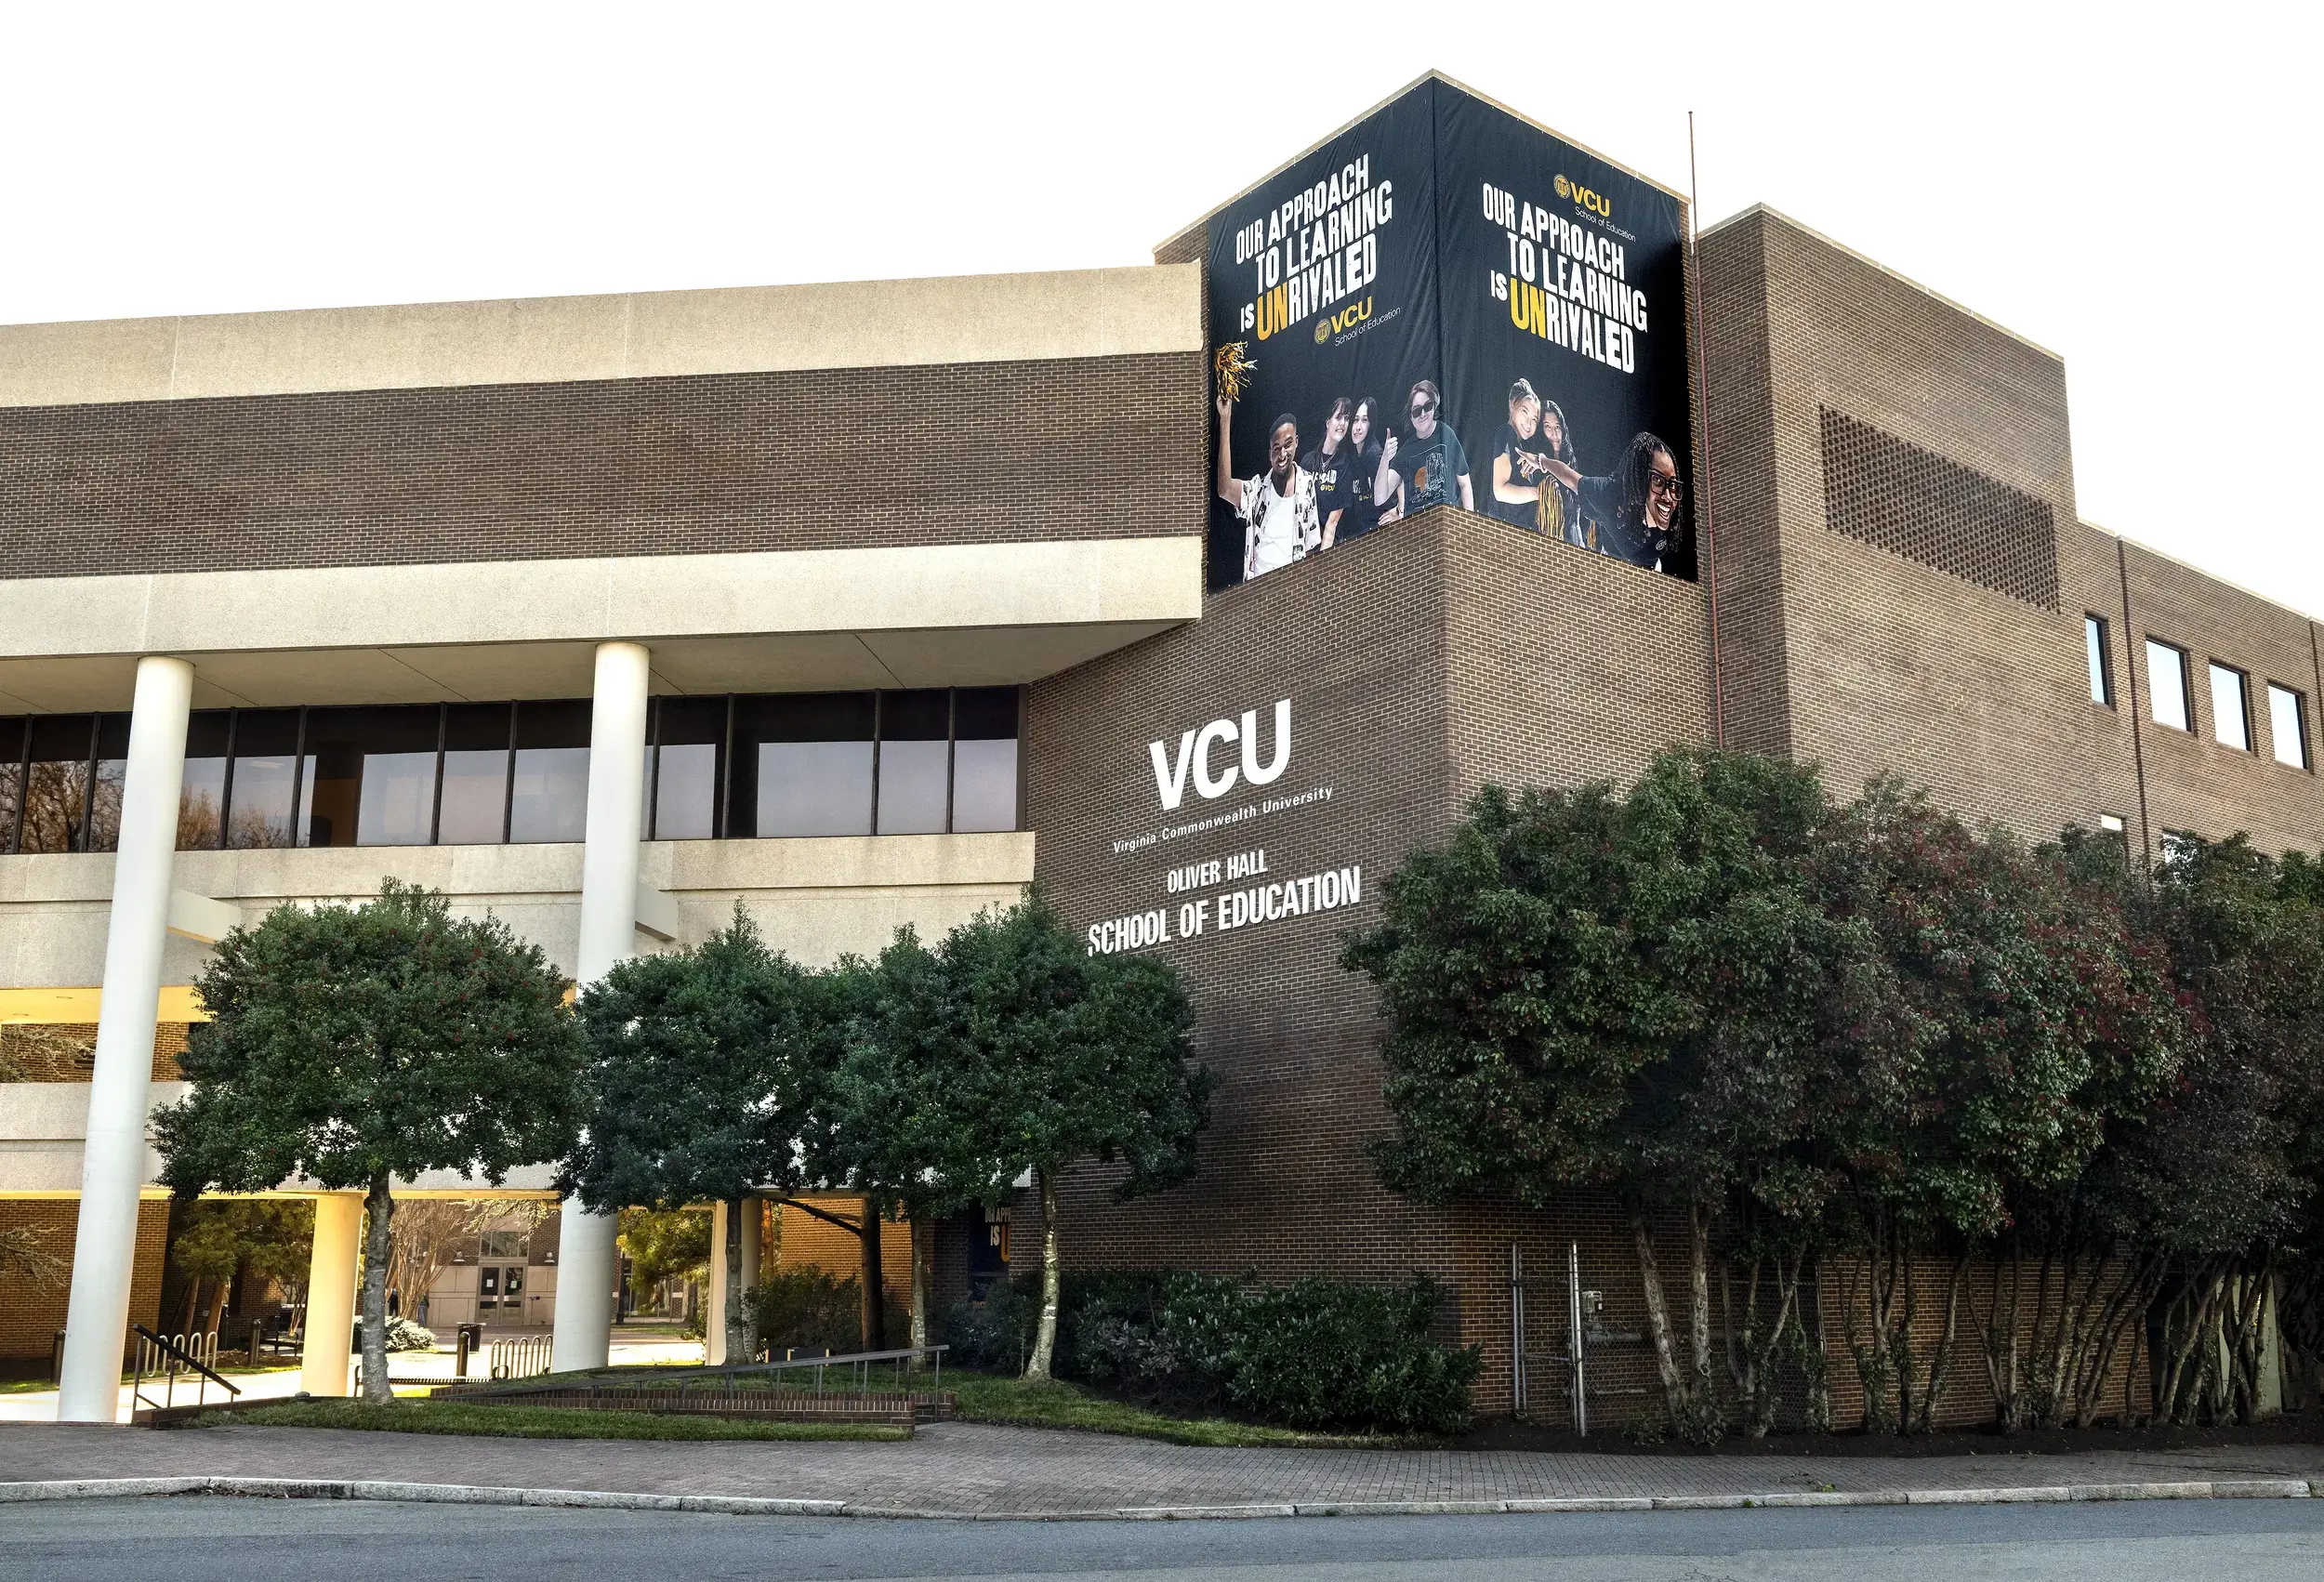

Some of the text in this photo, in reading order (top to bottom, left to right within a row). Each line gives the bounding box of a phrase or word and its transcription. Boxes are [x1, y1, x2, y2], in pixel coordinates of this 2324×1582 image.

[1236, 153, 1368, 265] OUR APPROACH
[1256, 179, 1393, 295] TO LEARNING
[1483, 182, 1625, 281] OUR APPROACH
[1570, 181, 1610, 217] VCU
[1575, 206, 1636, 243] School of Education
[1240, 232, 1377, 341] IS UNRIVALED
[1330, 296, 1372, 334] VCU
[1335, 307, 1401, 347] School of Education
[1491, 270, 1635, 375] IS UNRIVALED
[1507, 231, 1648, 333] TO LEARNING
[1149, 698, 1291, 811] VCU
[1113, 787, 1333, 853] Virginia Commonwealth University
[1088, 866, 1361, 957] SCHOOL OF EDUCATION
[1168, 850, 1268, 894] OLIVER HALL
[990, 1225, 1000, 1246] IS
